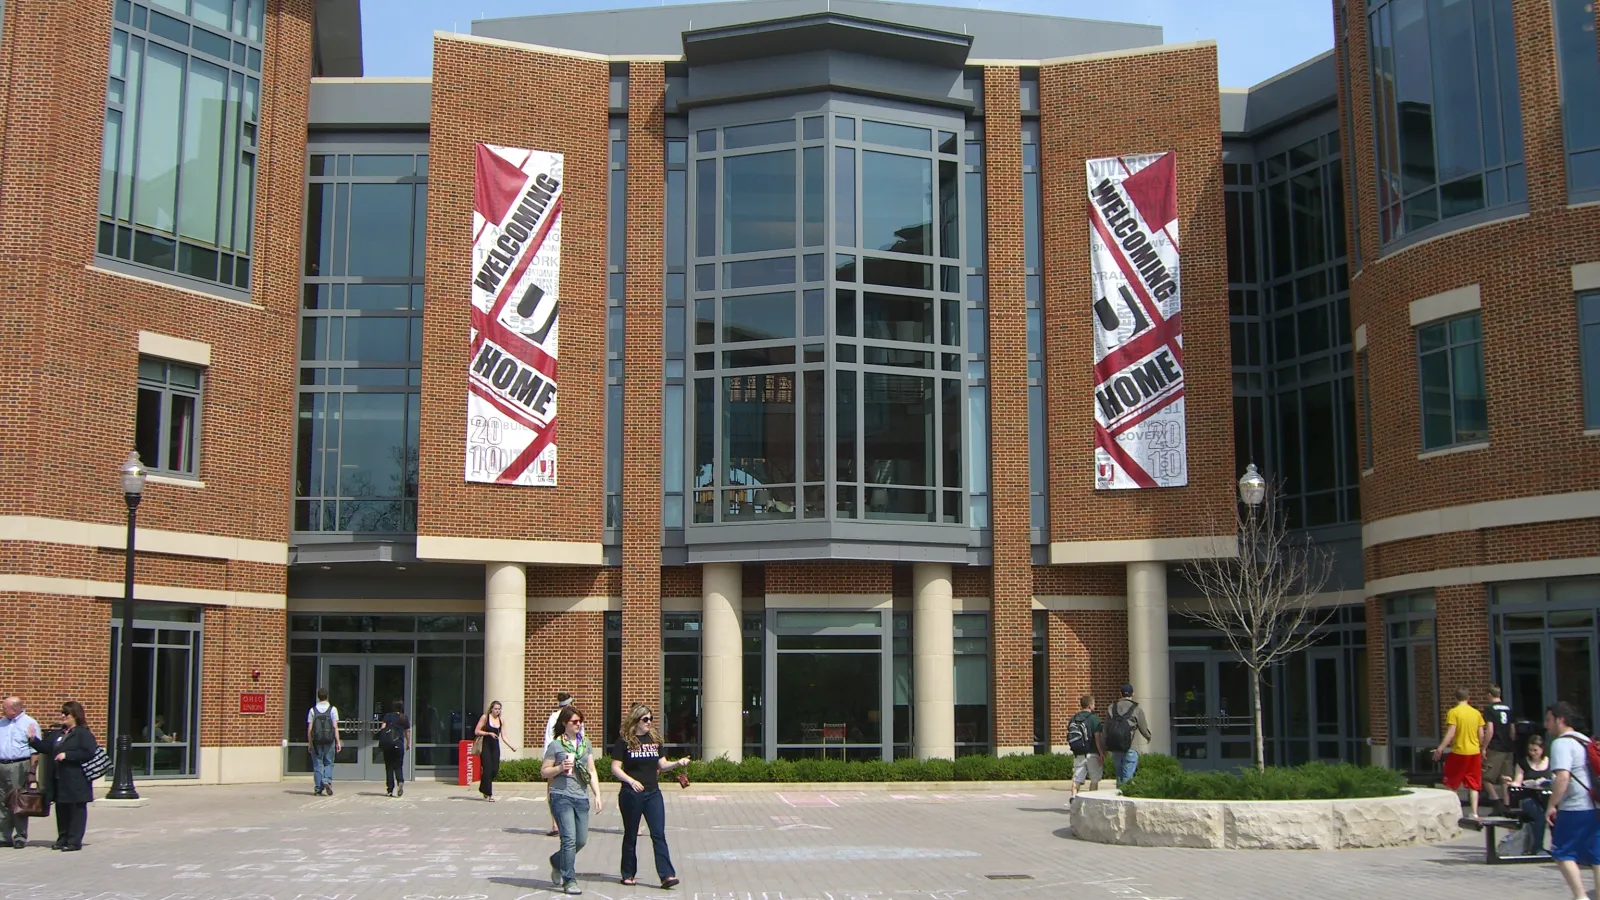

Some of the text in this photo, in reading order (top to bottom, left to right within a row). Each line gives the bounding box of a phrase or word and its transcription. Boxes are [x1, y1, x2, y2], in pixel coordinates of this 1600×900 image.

[474, 173, 560, 294] WELCOMING
[1091, 178, 1177, 303] WELCOMING
[473, 344, 556, 416] HOME
[1096, 350, 1182, 421] HOME
[470, 415, 503, 445] 20
[1148, 420, 1181, 449] 20
[469, 446, 502, 475] 10
[1148, 449, 1182, 478] 10
